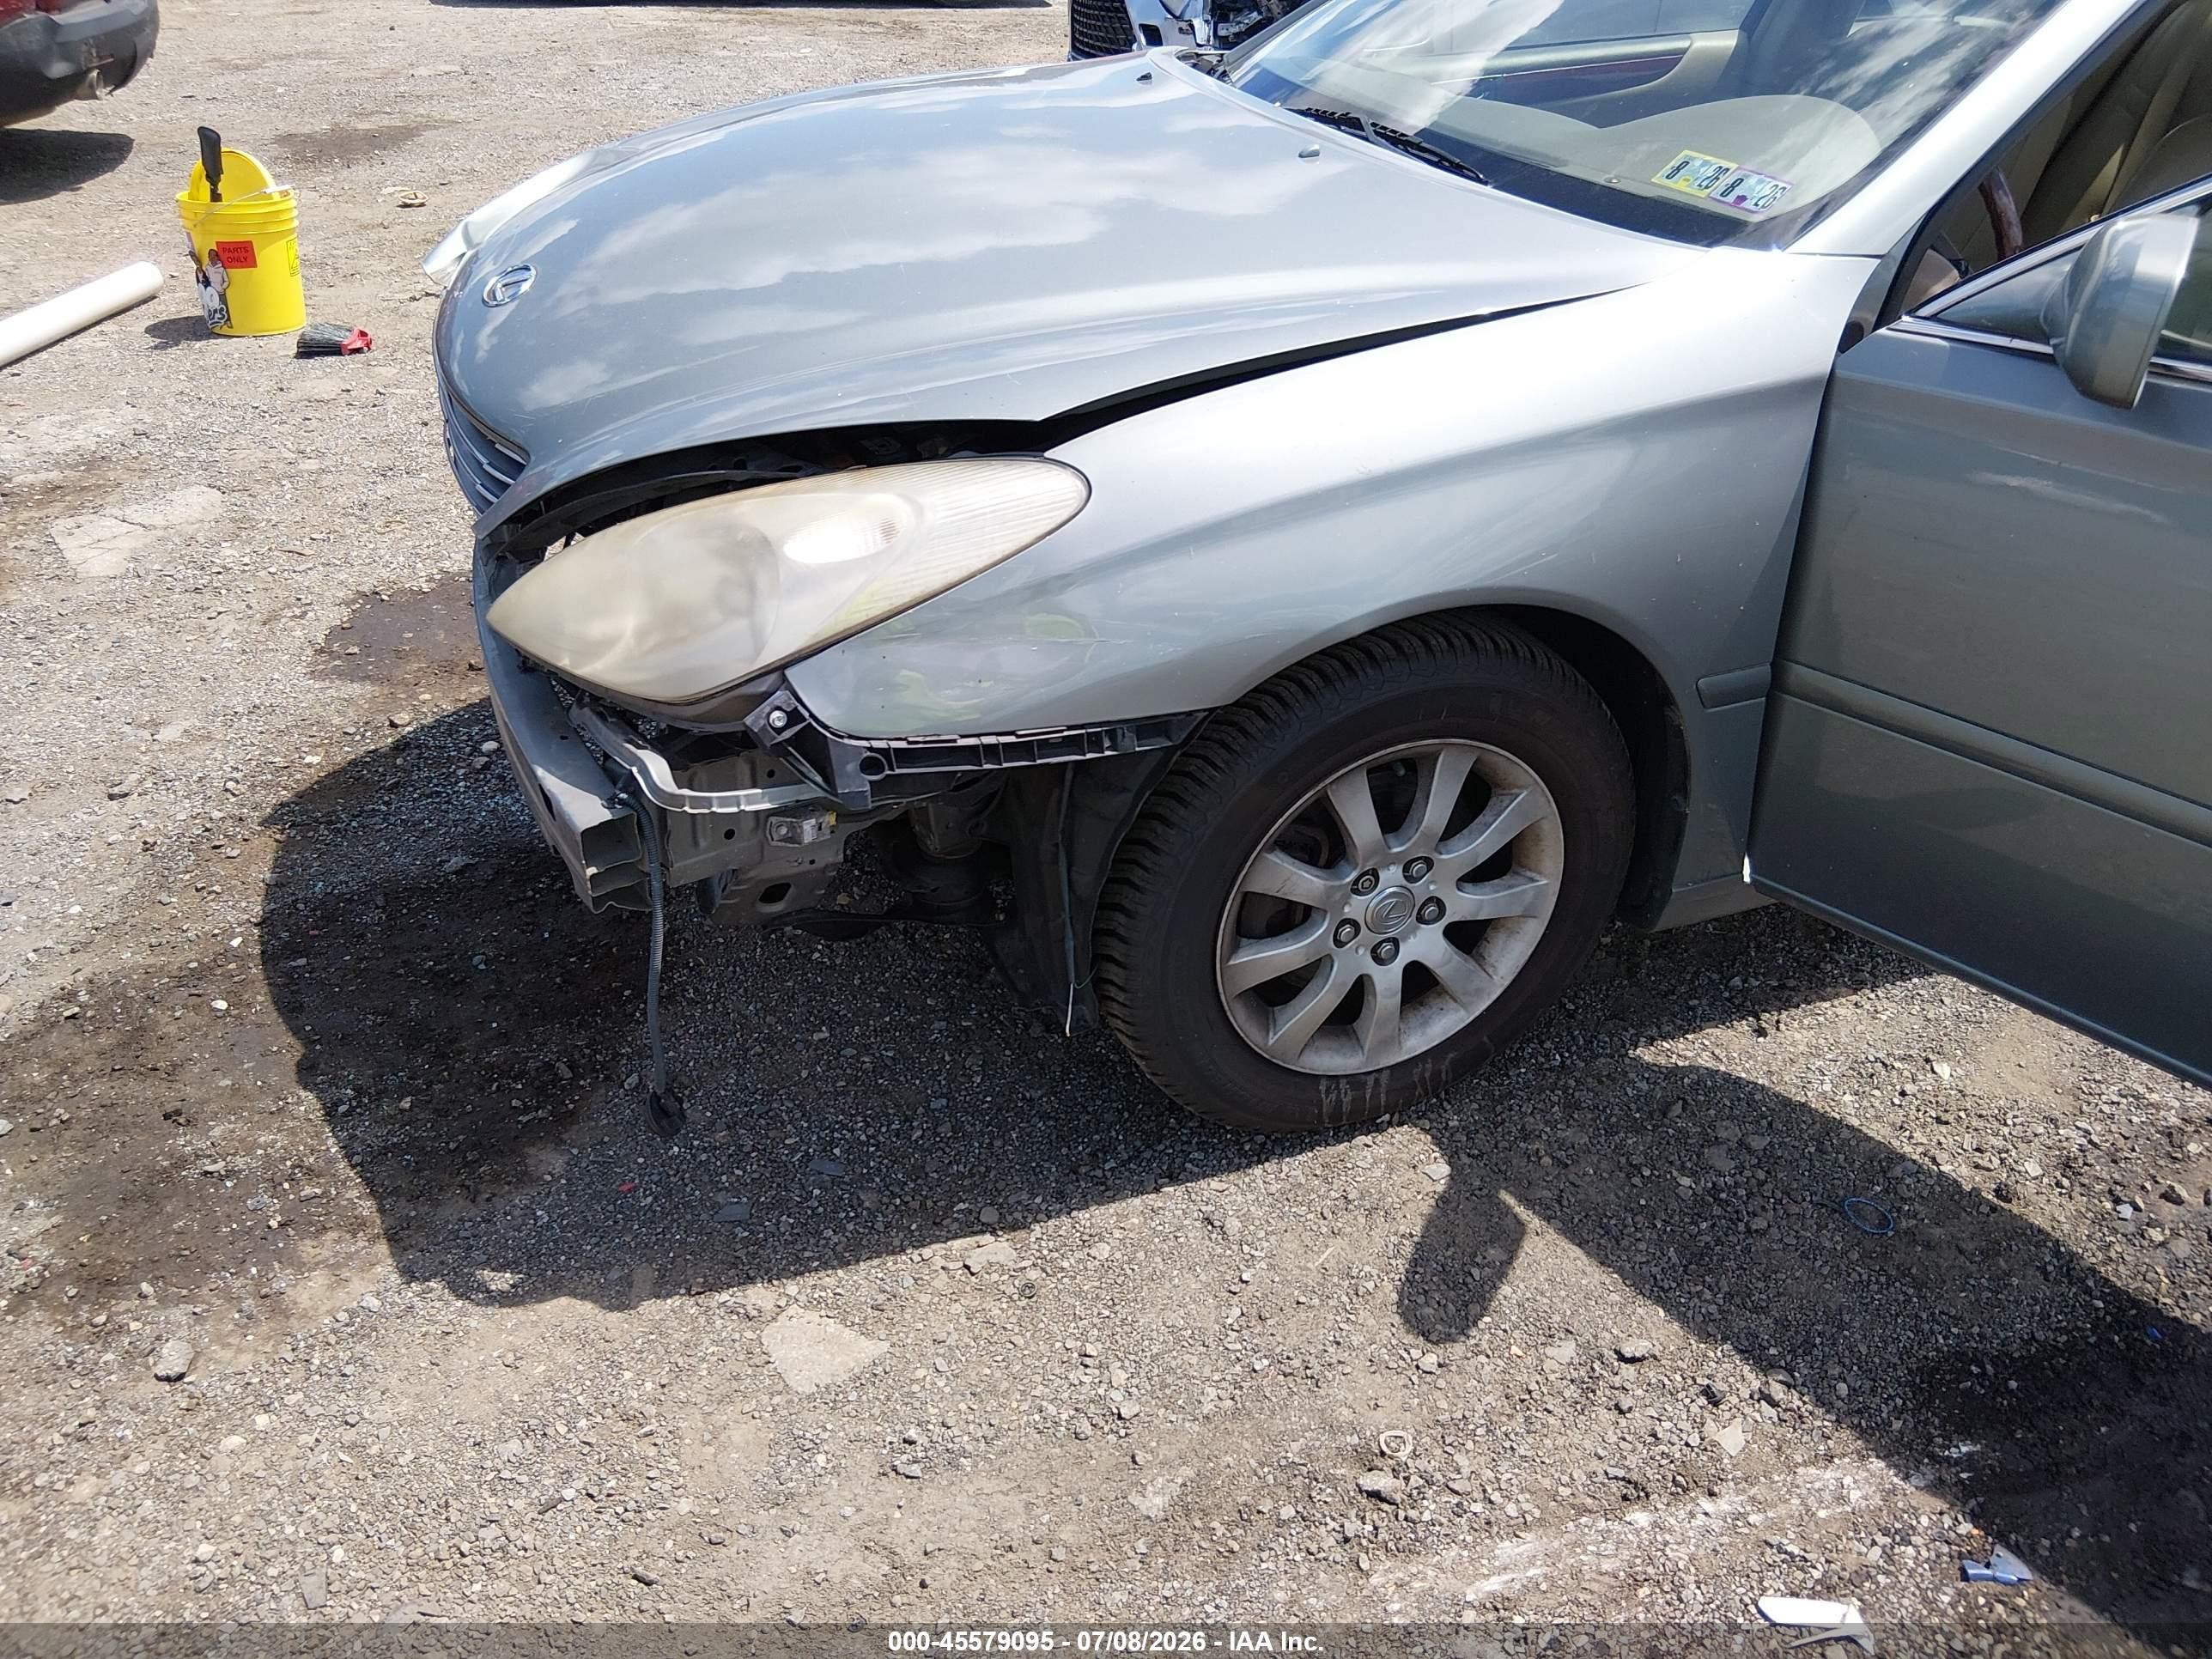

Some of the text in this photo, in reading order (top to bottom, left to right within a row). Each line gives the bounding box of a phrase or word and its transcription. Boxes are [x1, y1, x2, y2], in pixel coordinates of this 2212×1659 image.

[1665, 161, 1730, 190] 8 26
[1719, 177, 1787, 210] 8 26
[222, 246, 249, 254] PARTS
[207, 306, 226, 321] ers
